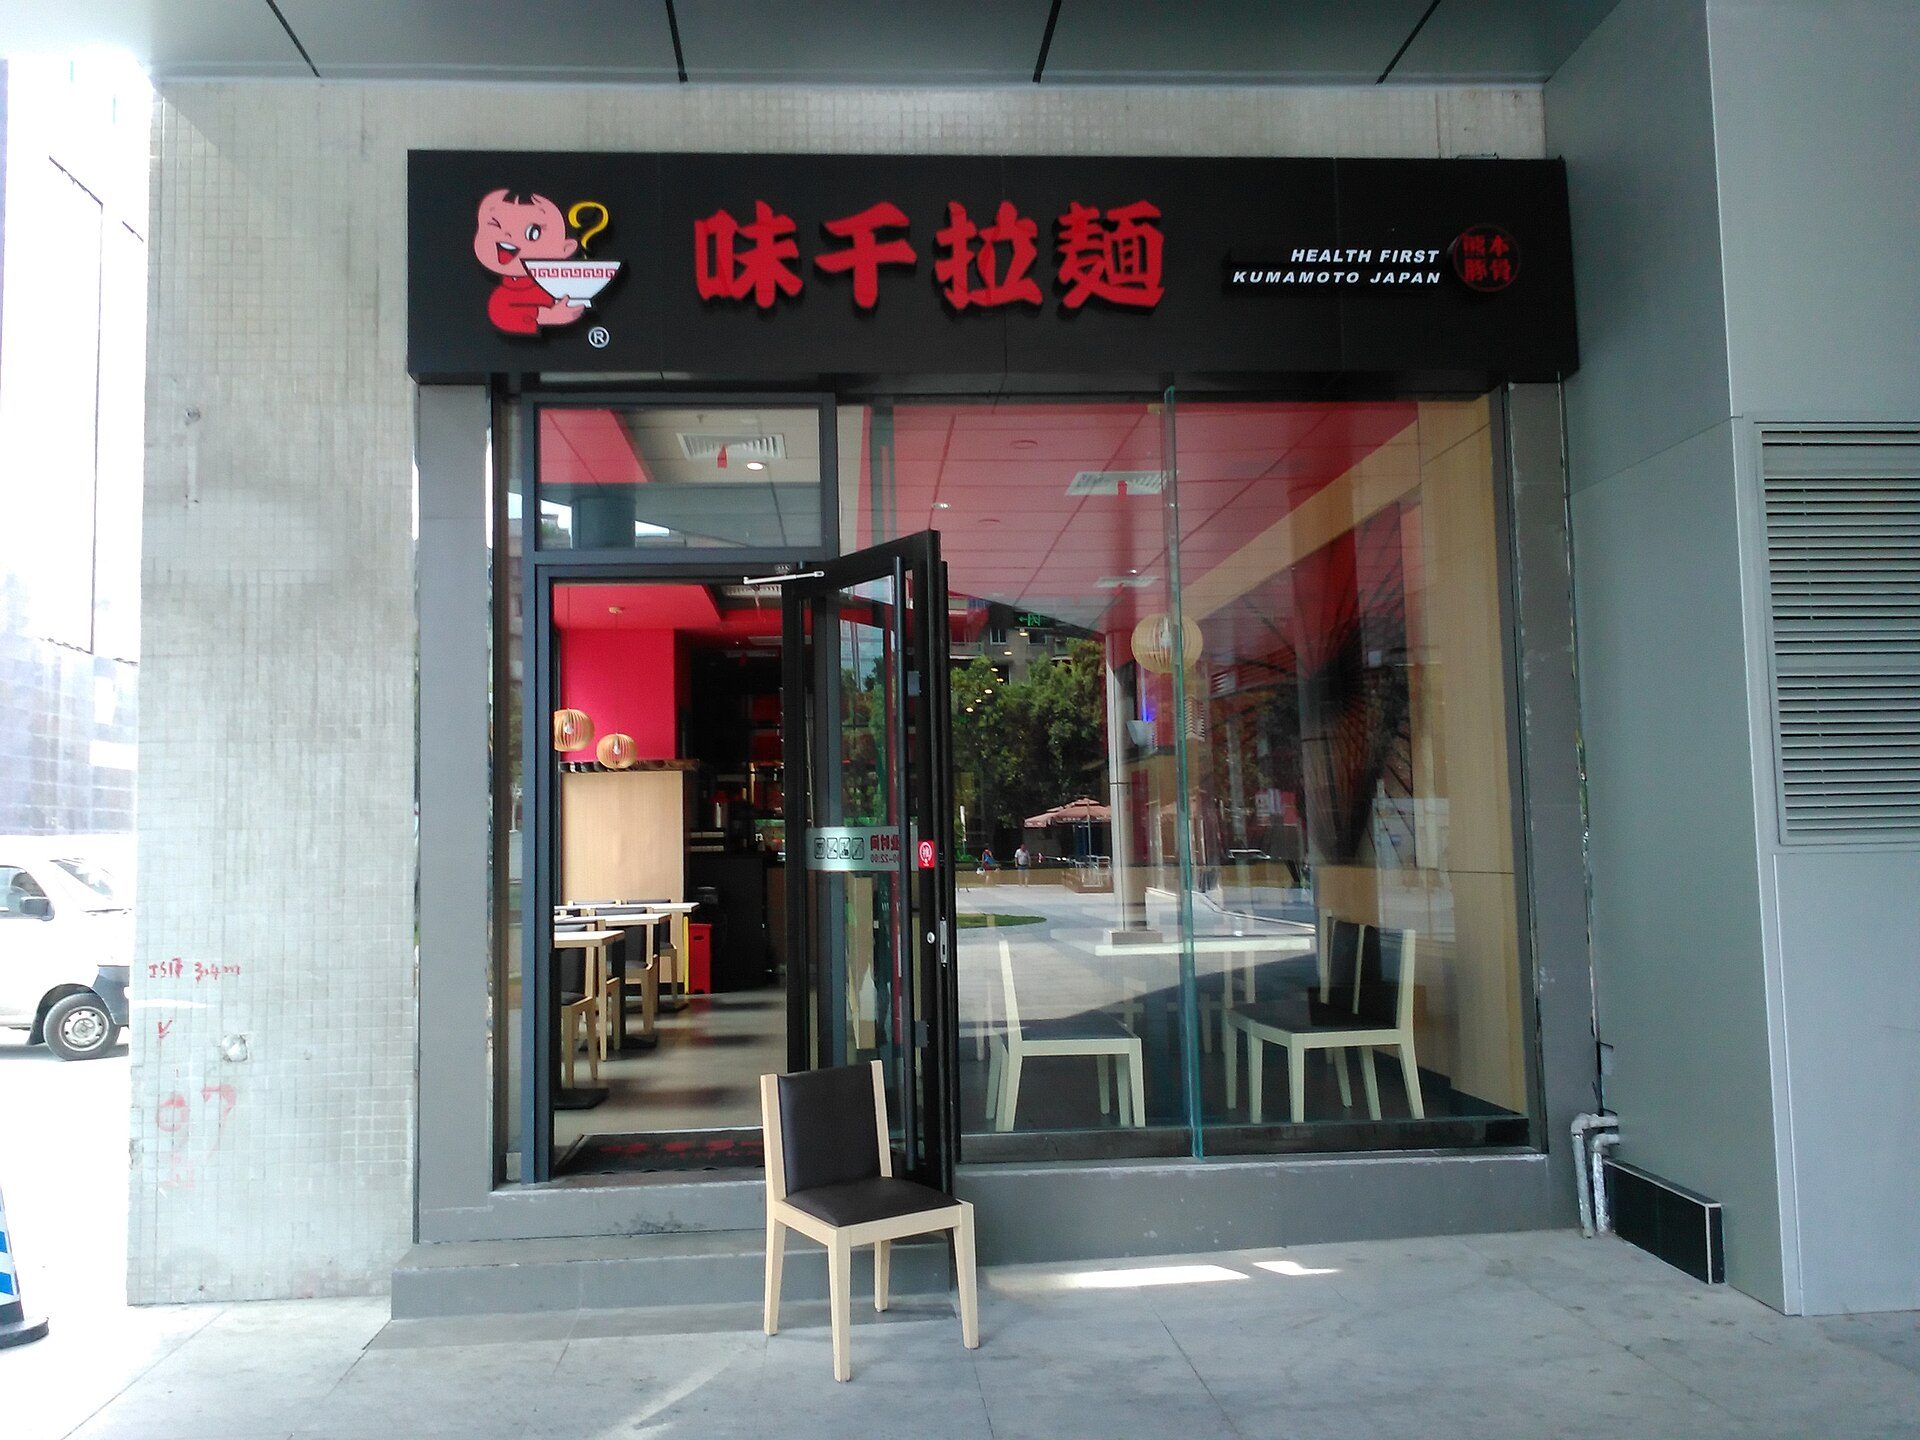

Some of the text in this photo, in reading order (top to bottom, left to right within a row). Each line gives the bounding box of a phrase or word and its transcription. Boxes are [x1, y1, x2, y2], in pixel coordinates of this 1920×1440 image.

[1290, 248, 1440, 264] HEALTH FIRST
[1232, 270, 1442, 285] KUMAMOTO JAPAN
